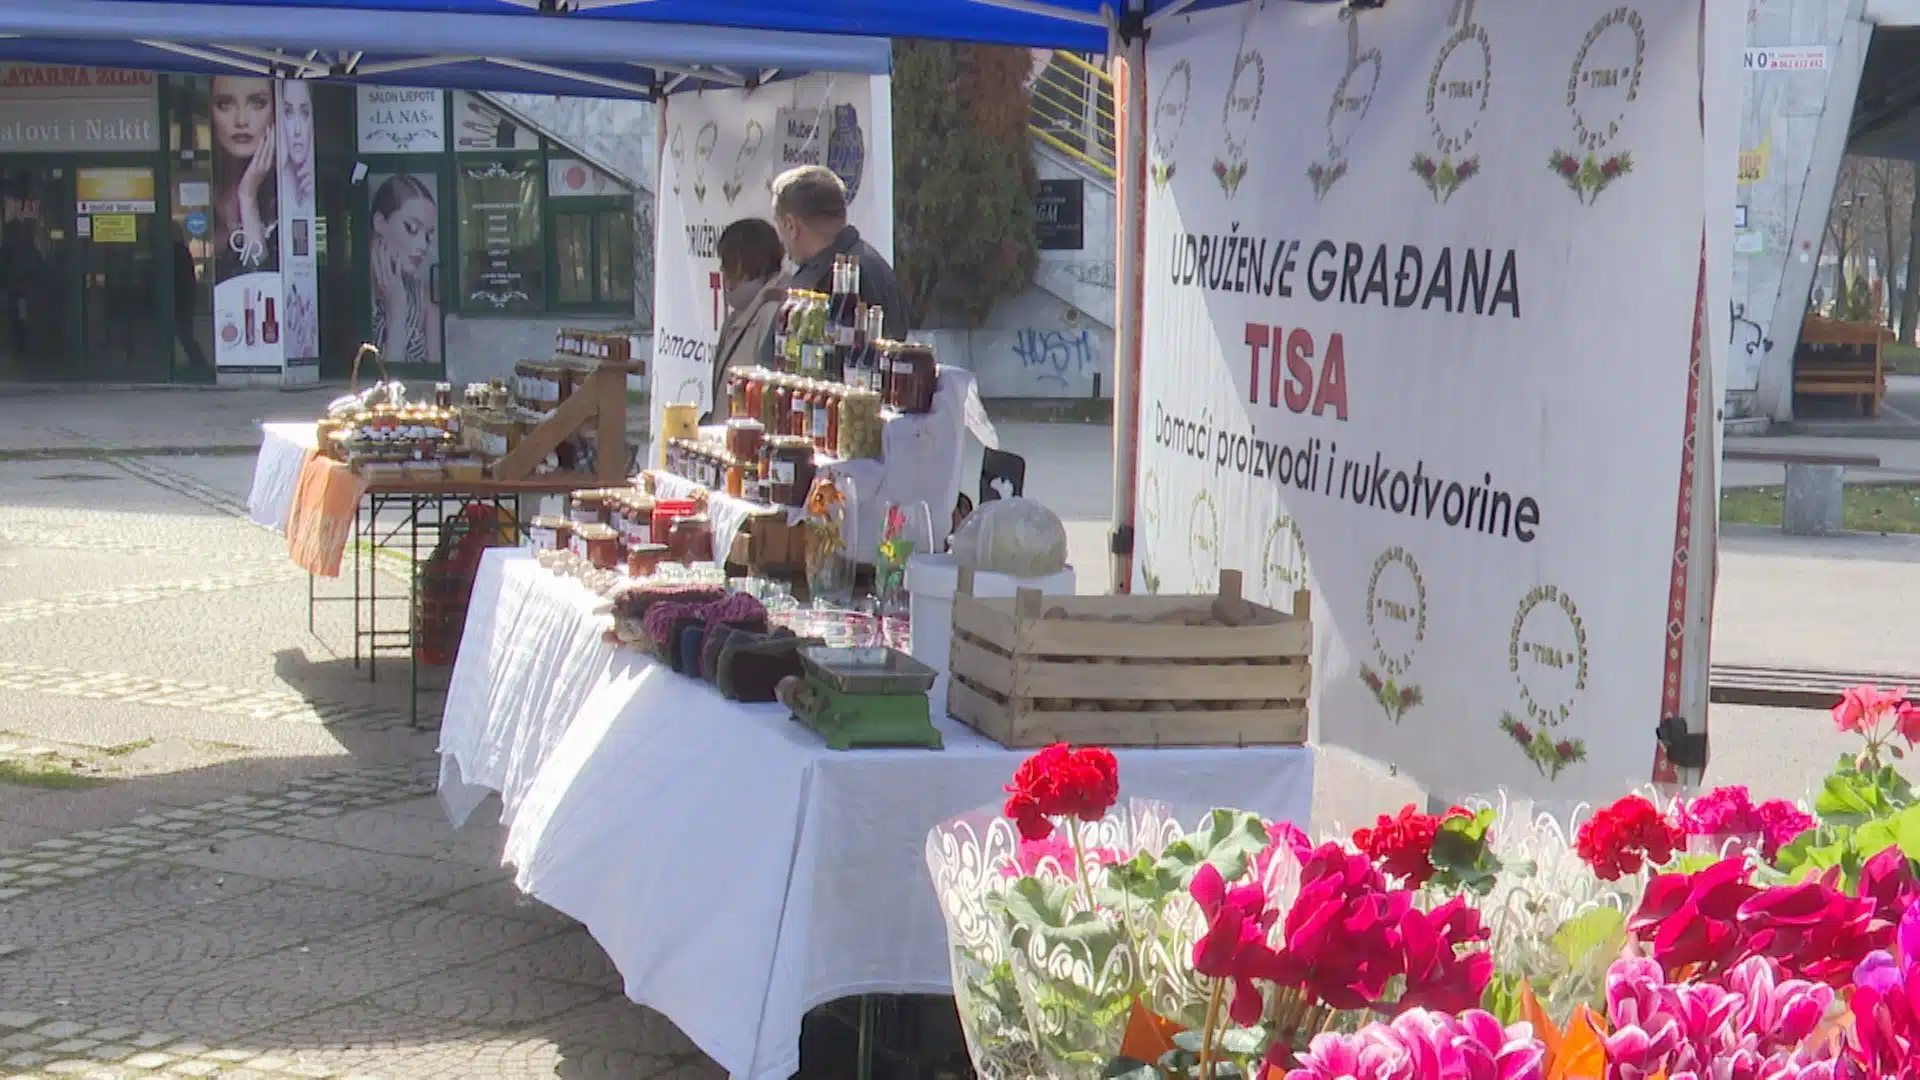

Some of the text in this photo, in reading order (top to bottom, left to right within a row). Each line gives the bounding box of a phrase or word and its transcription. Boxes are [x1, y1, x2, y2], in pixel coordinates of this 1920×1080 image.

[0, 120, 61, 141] atovi
[86, 118, 152, 141] Nakit
[1171, 222, 1521, 318] UDRUŽENJE GRAĐANA
[1244, 322, 1348, 421] TISA
[1155, 398, 1541, 544] Domaći proizvodi i rukotvorine
